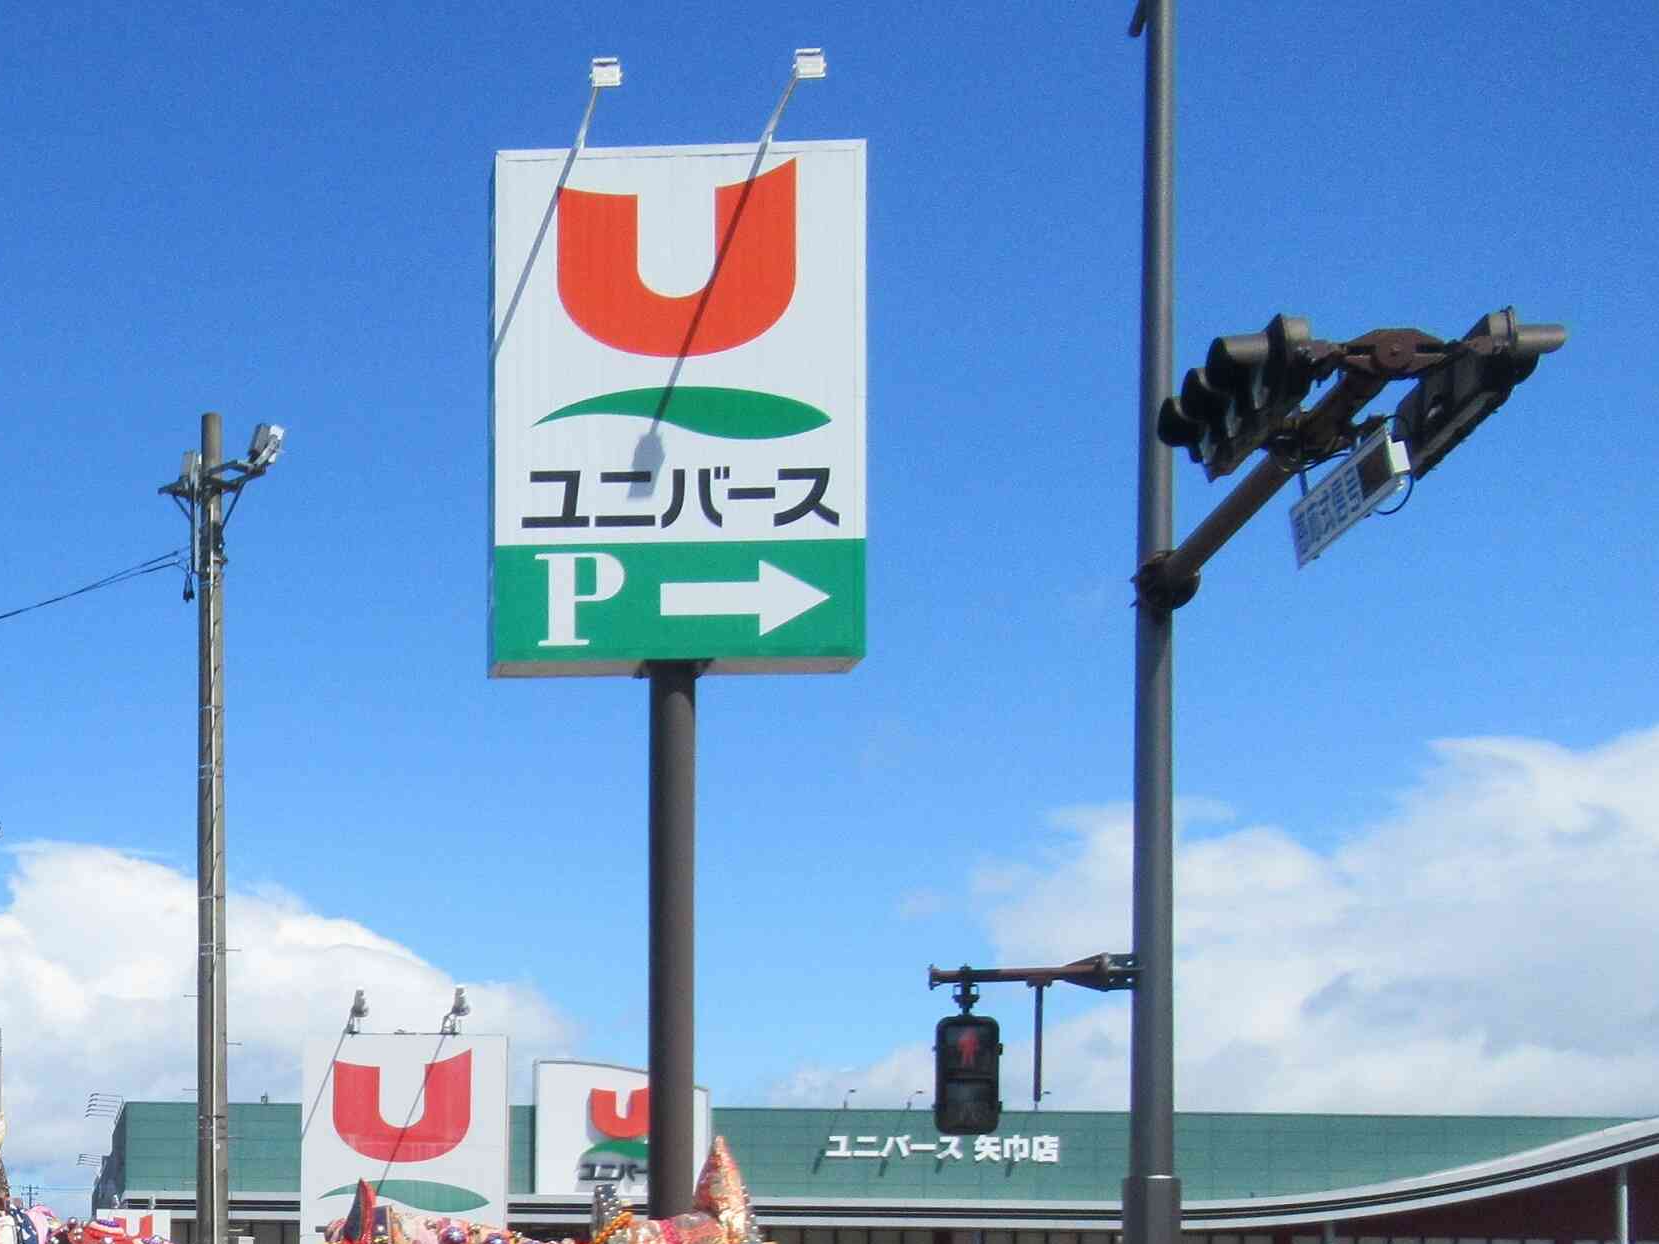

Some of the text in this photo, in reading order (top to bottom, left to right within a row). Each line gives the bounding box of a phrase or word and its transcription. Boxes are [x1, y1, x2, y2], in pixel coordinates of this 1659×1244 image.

[557, 157, 797, 358] U
[521, 466, 840, 529] ユニバース
[534, 551, 626, 647] P
[333, 1048, 472, 1163] U
[578, 1163, 649, 1181] ユニバー
[825, 1134, 1060, 1162] ユニバース 矢巾店
